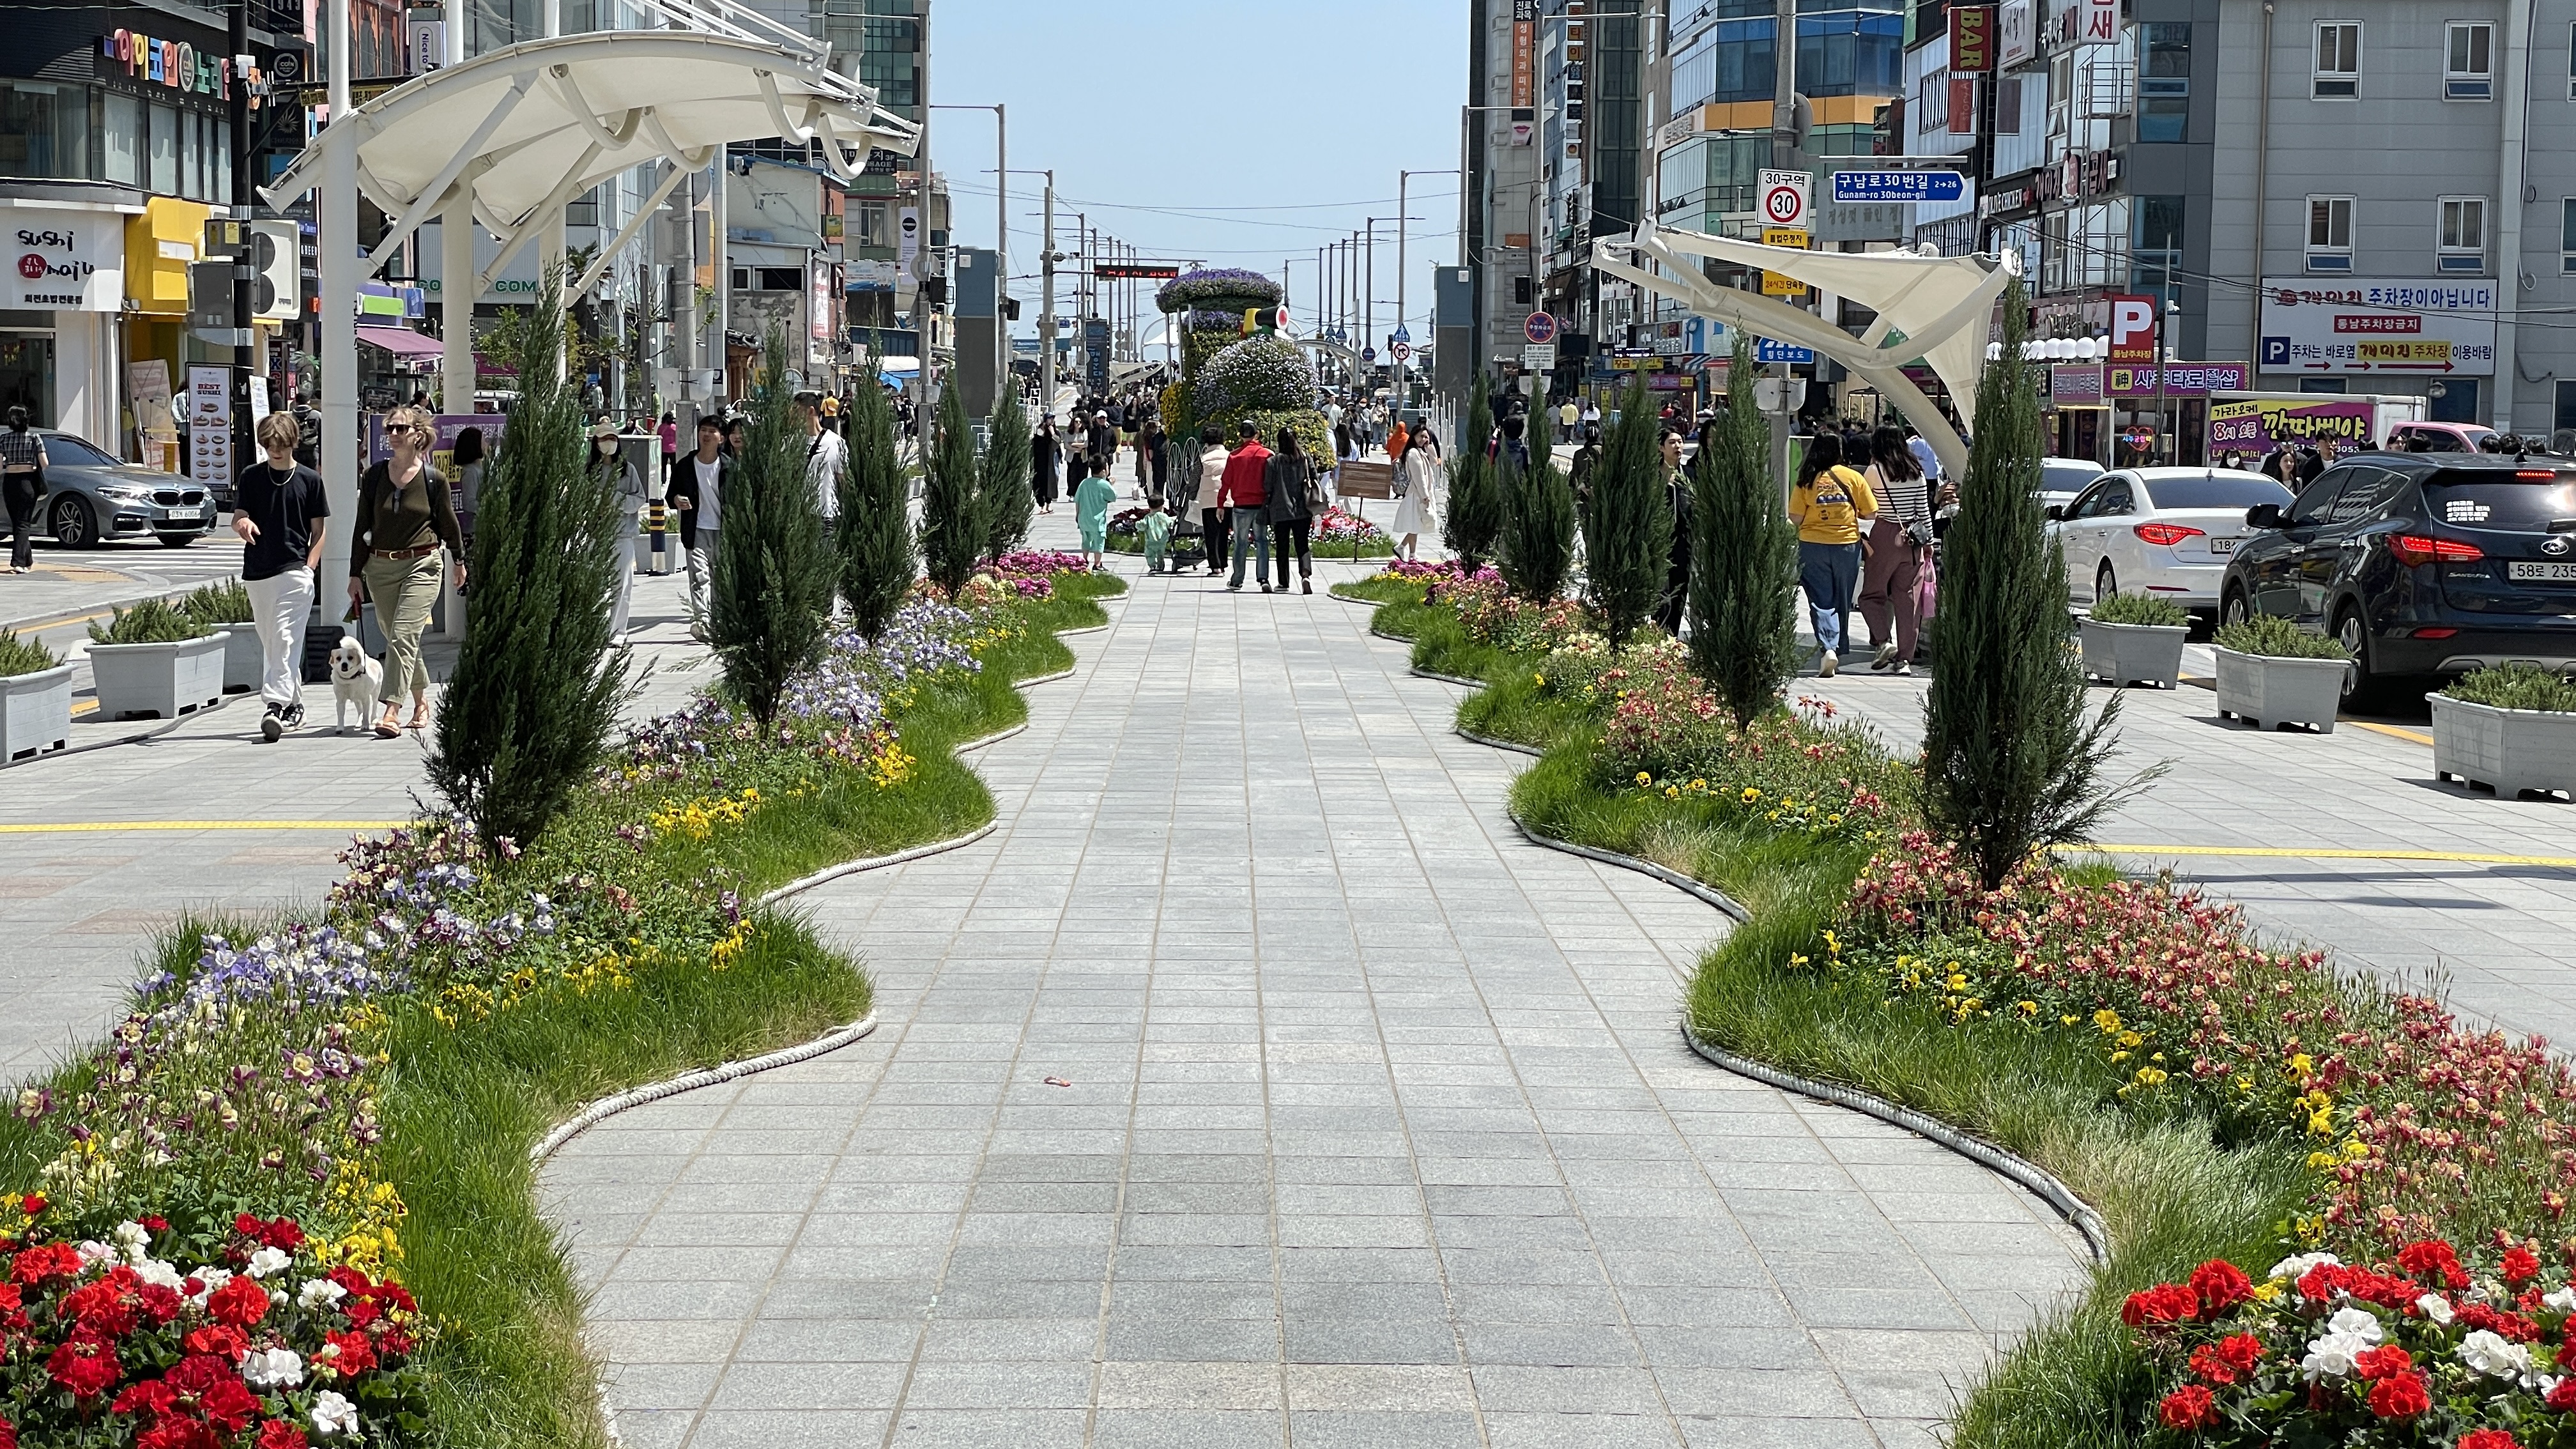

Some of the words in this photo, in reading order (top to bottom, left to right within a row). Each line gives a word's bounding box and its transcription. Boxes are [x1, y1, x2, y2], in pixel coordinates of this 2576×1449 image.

[1515, 1, 1532, 10] 진료
[1515, 11, 1532, 20] 과목
[2088, 0, 2114, 40] 새
[1960, 10, 1983, 68] BAR
[422, 55, 429, 64] to
[1765, 173, 1805, 187] 30구역
[1838, 190, 1879, 199] Gunam-ro
[1880, 190, 1927, 200] 30beon-gil
[1774, 194, 1794, 214] 30
[1770, 234, 1802, 243] 불법주정차
[494, 280, 537, 291] COM
[1765, 280, 1785, 289] 24시간
[2368, 288, 2490, 308] 주차장이아닙니다
[2113, 301, 2152, 345] P
[2337, 318, 2418, 330] 동남주차장금지
[1767, 350, 1805, 360] 횡단보도
[2113, 349, 2152, 359] 동남주차장
[2269, 342, 2285, 360] P
[2291, 344, 2322, 359] 주차는
[2326, 344, 2356, 360] 바로옆
[2359, 344, 2411, 359] 개미집
[2415, 345, 2448, 358] 주차장
[2452, 345, 2492, 360] 이용바람
[2115, 371, 2129, 387] 神
[2214, 404, 2258, 417] 가라오케
[2213, 422, 2236, 441] 8시
[2238, 422, 2258, 439] 오픈
[2517, 564, 2545, 578] 58로
